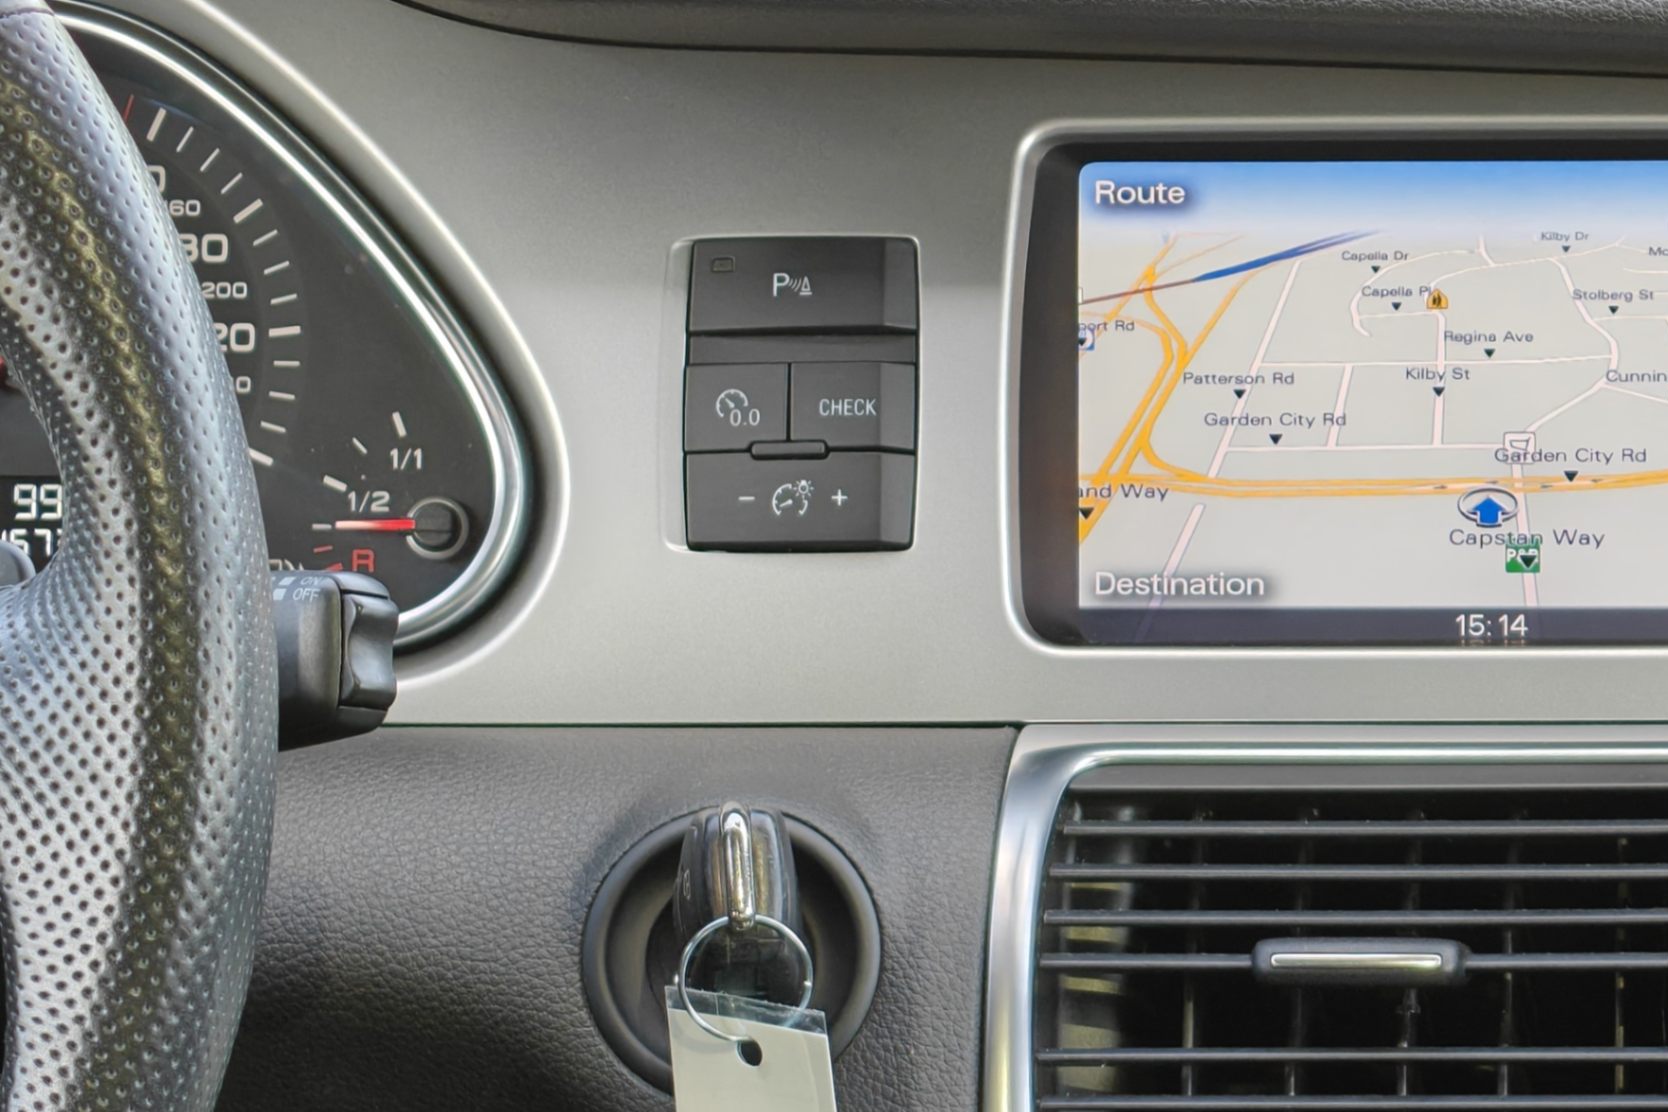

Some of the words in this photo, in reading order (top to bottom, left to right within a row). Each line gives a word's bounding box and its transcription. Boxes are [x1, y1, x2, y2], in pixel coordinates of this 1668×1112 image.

[1095, 180, 1186, 205] Route
[164, 199, 201, 217] 60
[1540, 231, 1570, 243] Kilby
[1575, 231, 1589, 242] Dr
[1341, 250, 1389, 262] Capella
[1393, 250, 1409, 261] Dr
[201, 281, 248, 299] 200
[1361, 285, 1413, 298] Capella
[1572, 288, 1633, 302] Stolberg
[1638, 288, 1655, 300] St
[1114, 319, 1136, 332] Rd
[213, 322, 256, 353] 20
[1444, 331, 1497, 345] Regina
[1502, 331, 1534, 343] Ave
[1183, 372, 1266, 385] Patterson
[1272, 372, 1295, 385] Rd
[1405, 367, 1446, 383] Kilby
[1452, 367, 1470, 380] St
[818, 398, 877, 417] CHECK
[1204, 412, 1272, 426] Garden
[1279, 412, 1315, 429] City
[1323, 412, 1347, 426] Rd
[390, 448, 423, 470] 1/1
[1494, 448, 1567, 463] Garden
[1575, 447, 1614, 465] City
[1622, 448, 1647, 463] Rd
[1121, 483, 1169, 502] Way
[347, 491, 390, 513] 1/2
[1449, 528, 1544, 549] Capstan
[1553, 528, 1605, 549] Way
[1095, 571, 1265, 597] Destination
[292, 587, 321, 602] OFF
